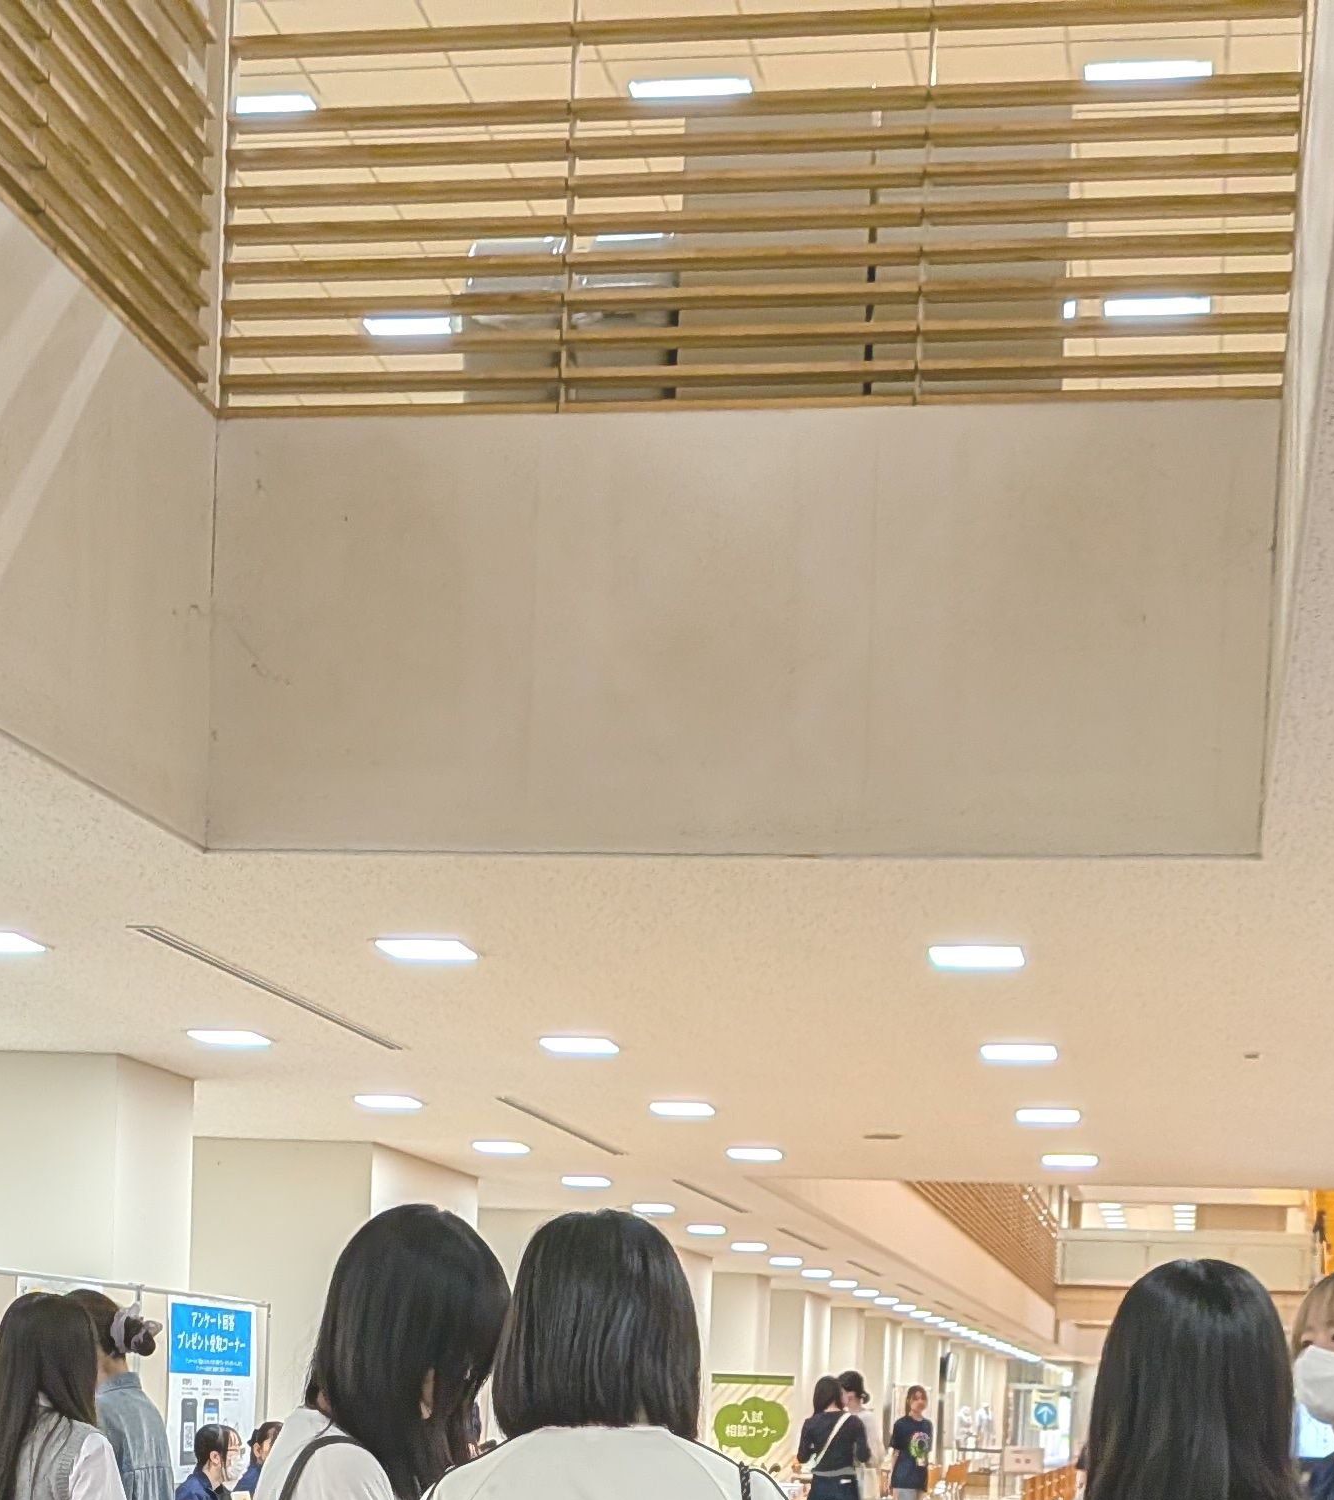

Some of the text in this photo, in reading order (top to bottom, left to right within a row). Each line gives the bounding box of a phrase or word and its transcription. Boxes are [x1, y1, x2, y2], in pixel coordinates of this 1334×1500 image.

[191, 1311, 235, 1331] アンケート回答
[177, 1331, 246, 1353] プレゼント受取コーナー
[740, 1410, 763, 1424] 入試
[725, 1424, 777, 1438] 相談コーナー
